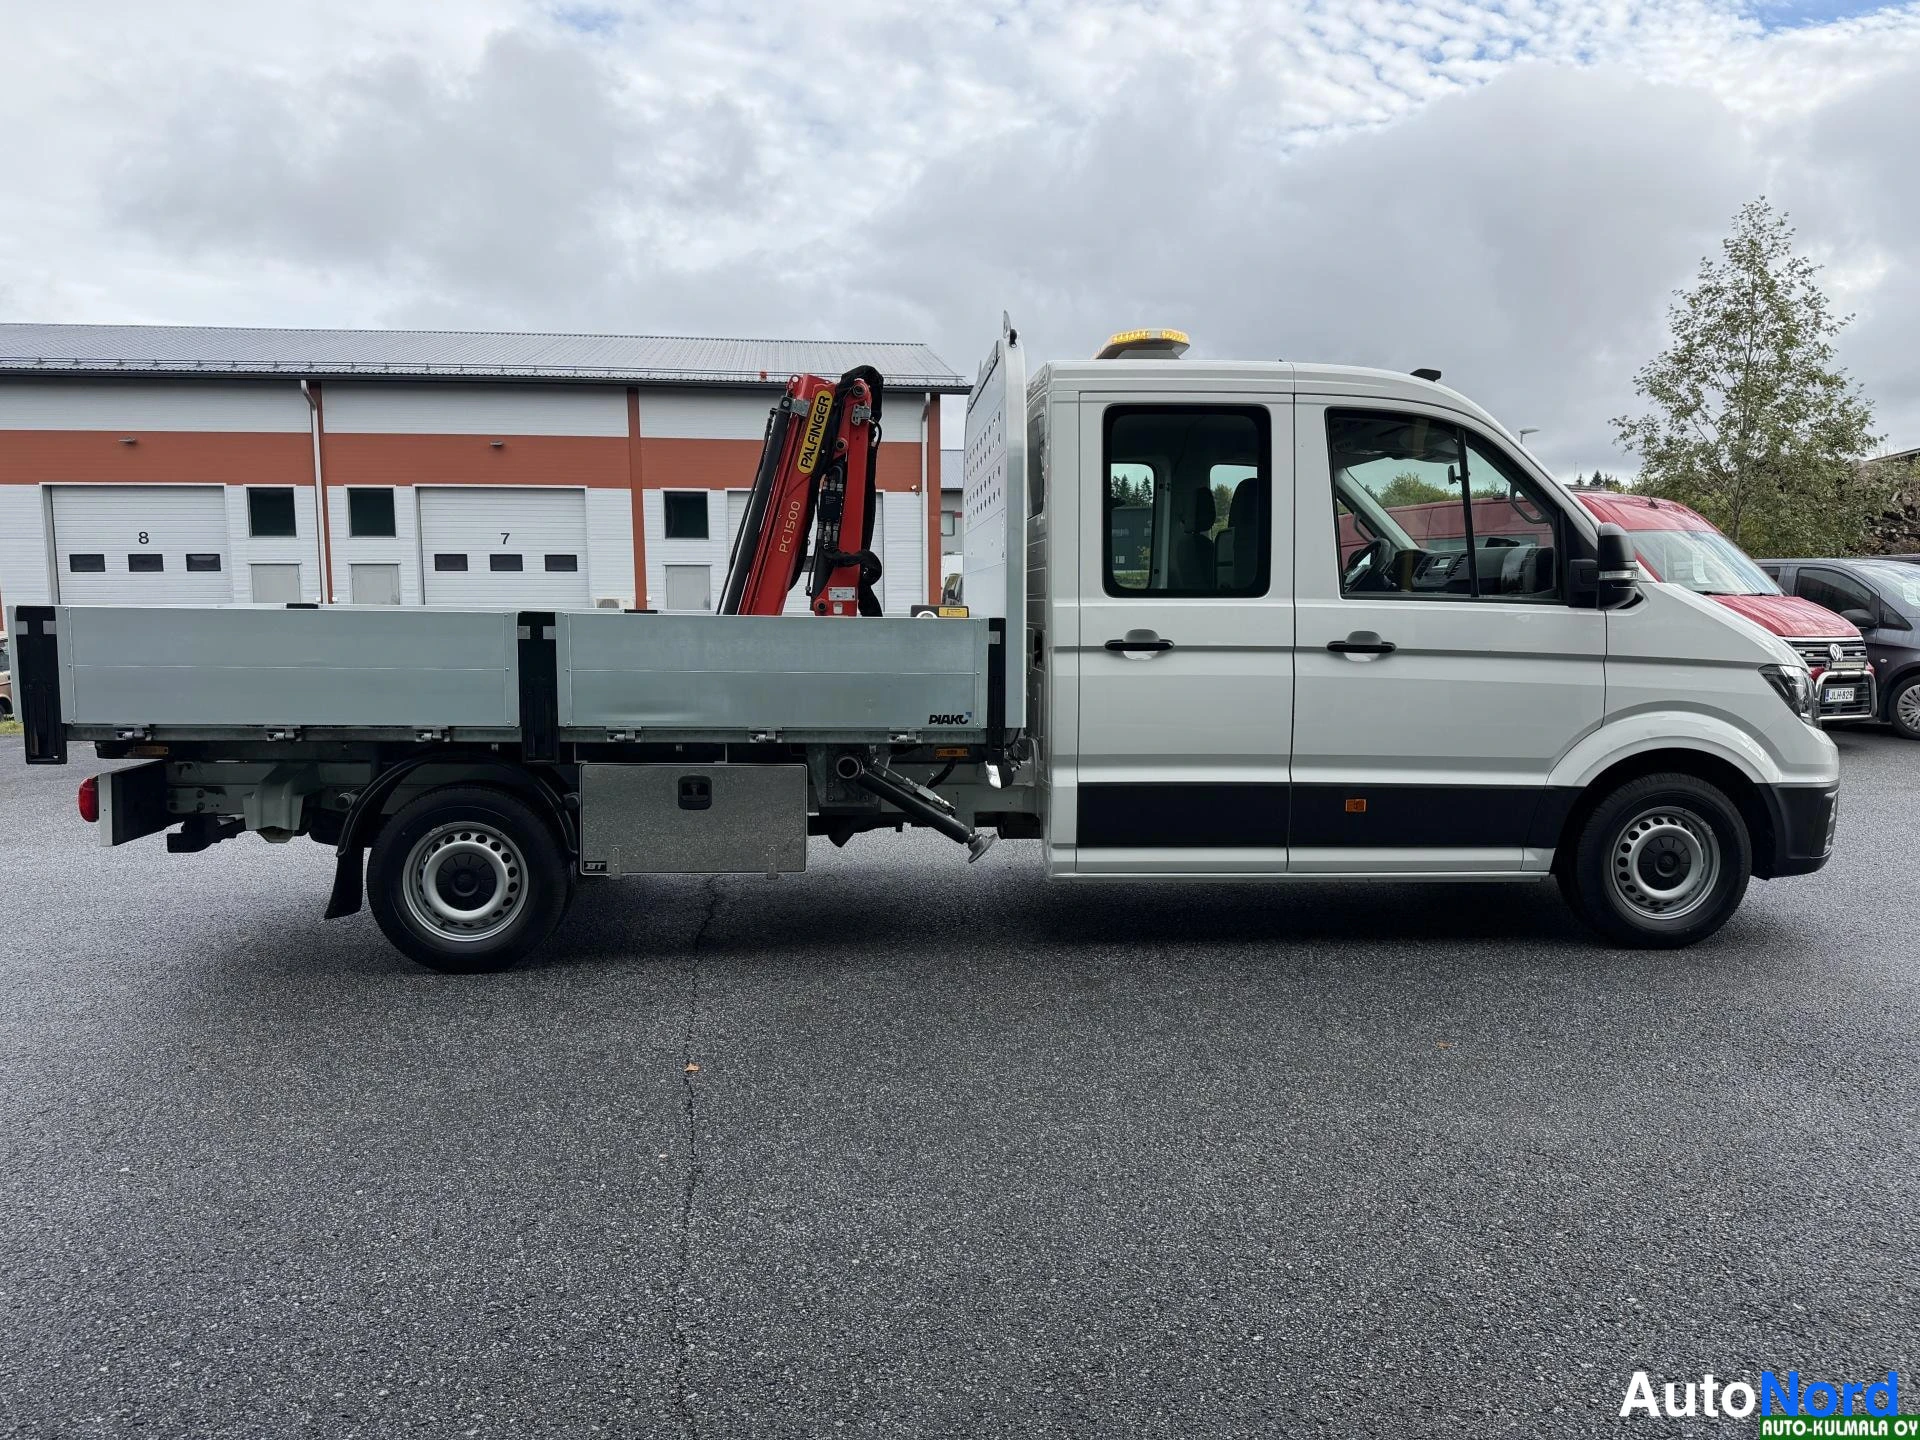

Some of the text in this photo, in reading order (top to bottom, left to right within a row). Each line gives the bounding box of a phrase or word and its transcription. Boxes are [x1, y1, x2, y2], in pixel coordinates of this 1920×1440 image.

[801, 395, 830, 469] PALFINGER
[138, 531, 149, 544] 8
[500, 532, 510, 545] 7
